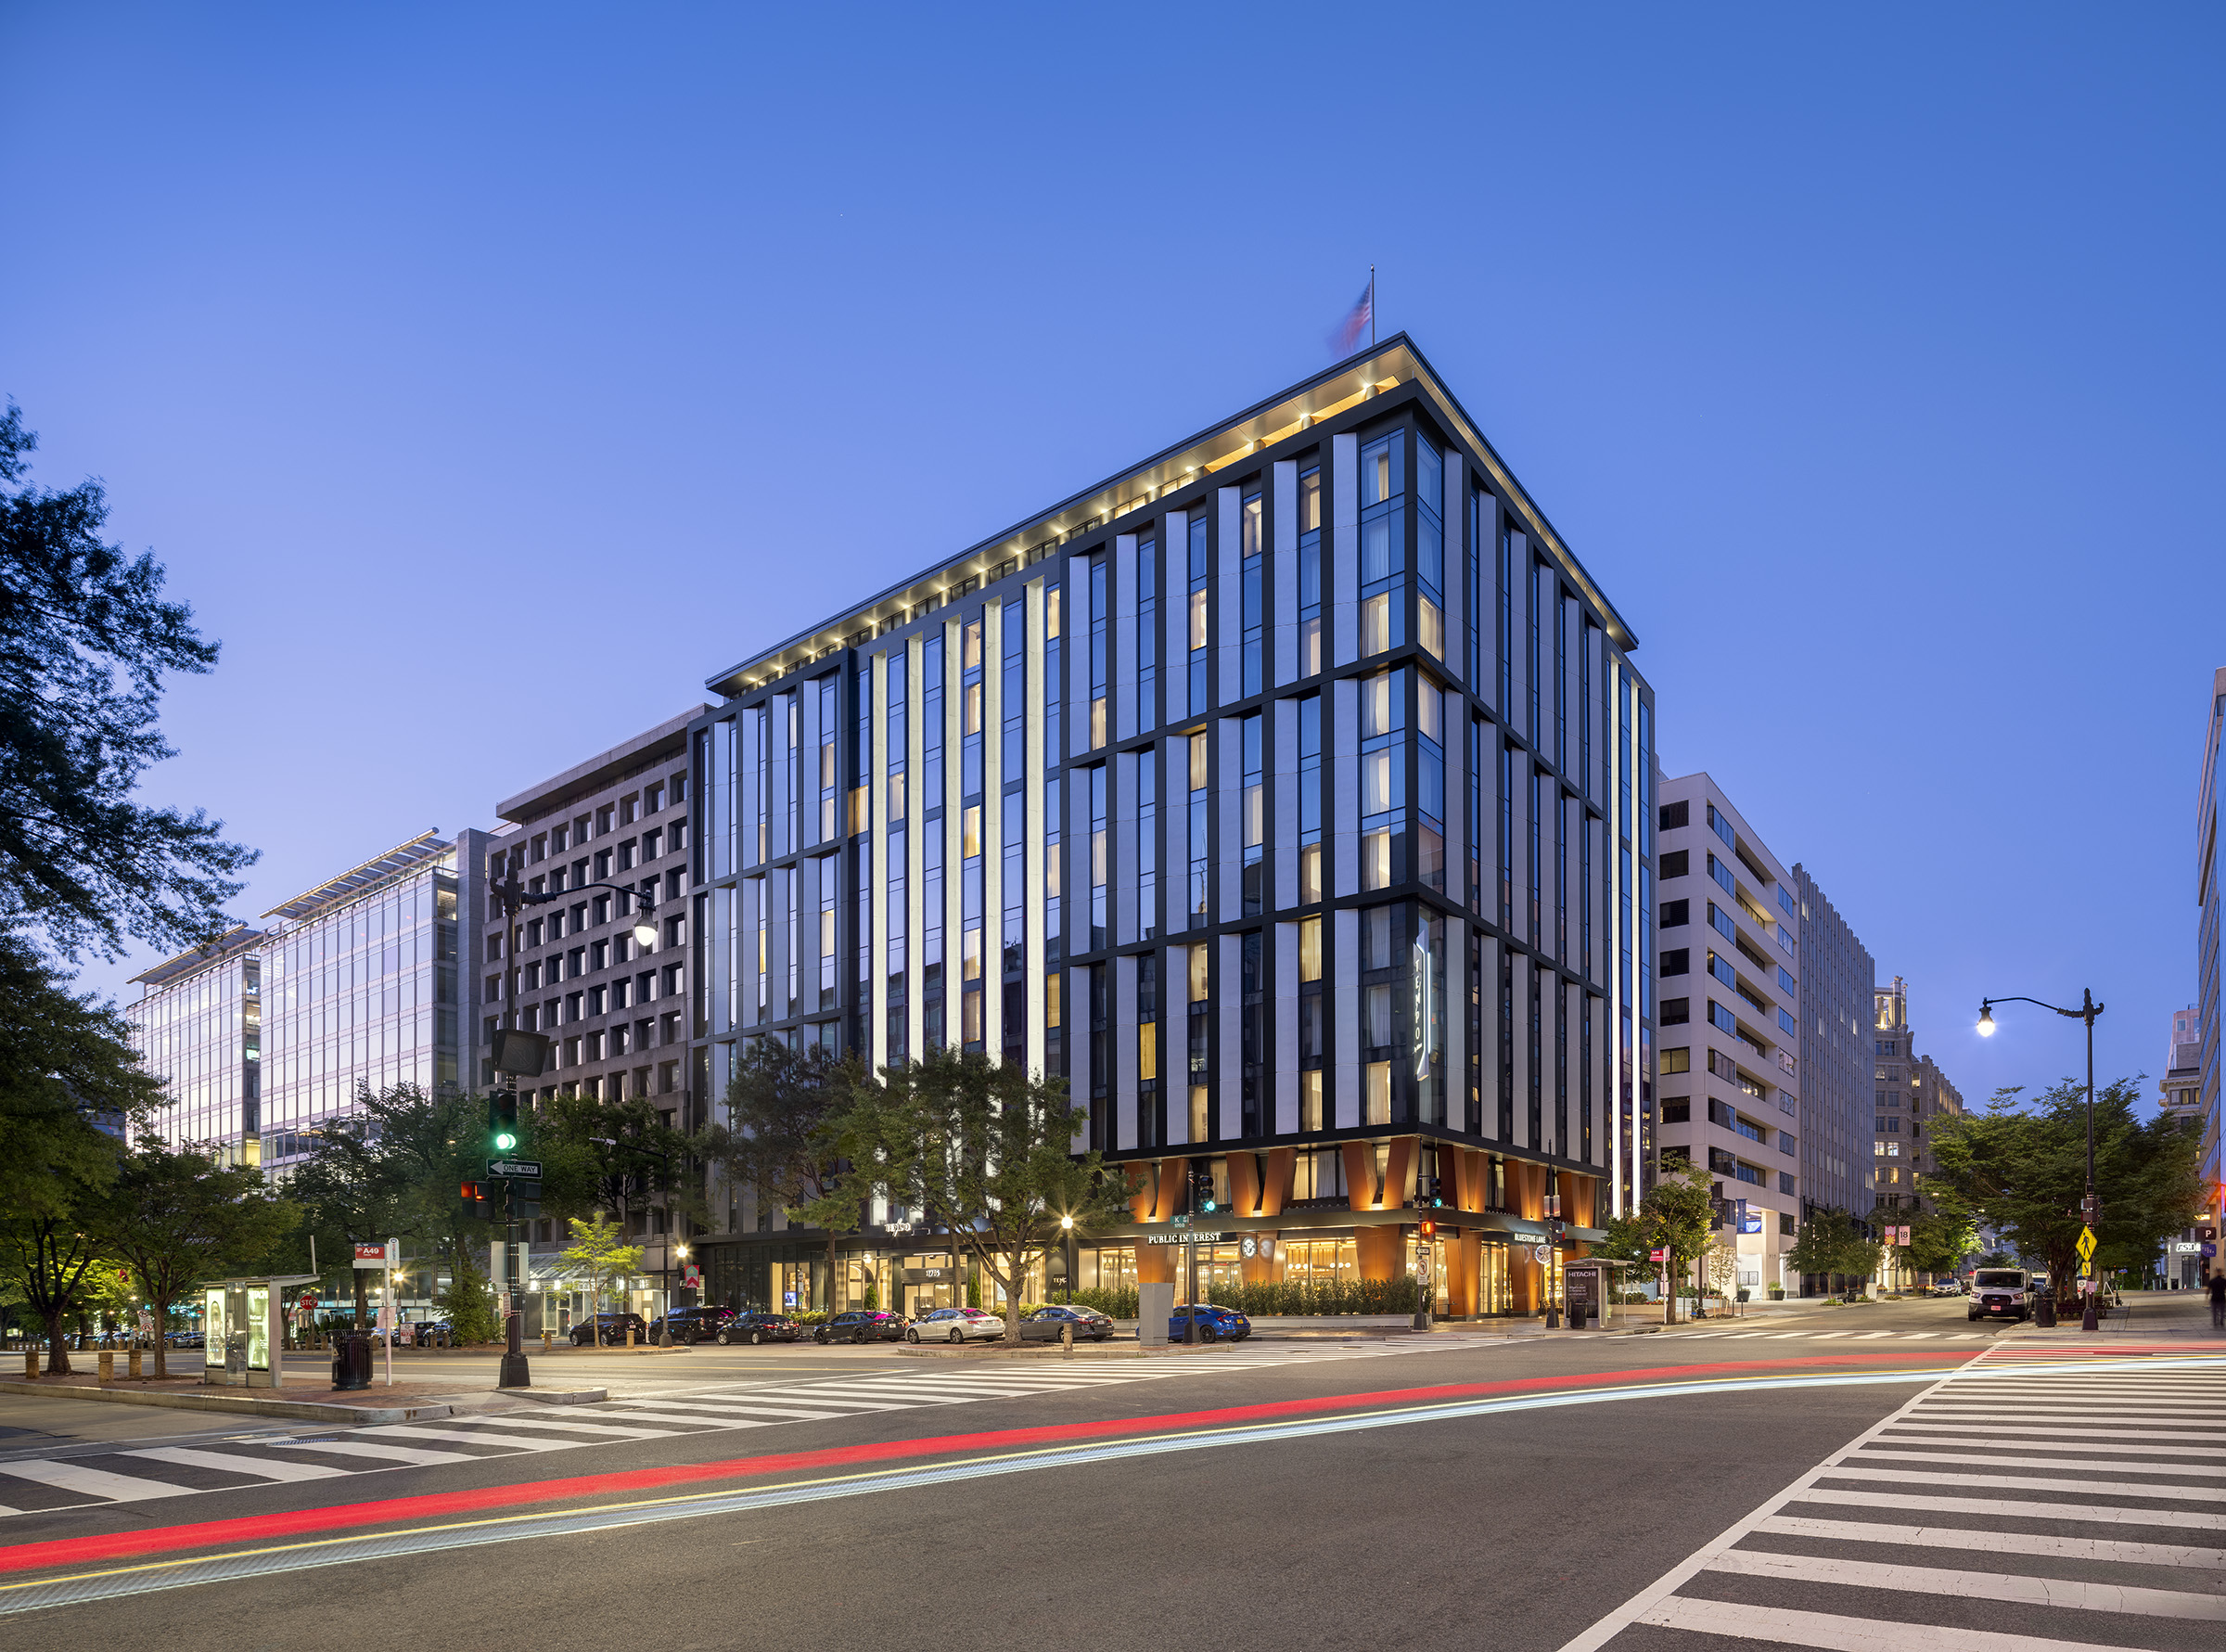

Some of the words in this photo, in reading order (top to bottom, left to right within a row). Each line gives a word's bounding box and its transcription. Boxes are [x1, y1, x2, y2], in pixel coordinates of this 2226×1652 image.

[503, 1164, 518, 1172] ONE
[520, 1165, 536, 1173] WAY
[1148, 1235, 1178, 1244] PUBLIC
[1179, 1232, 1222, 1243] INEREST
[1514, 1233, 1536, 1243] BLUESTONE
[1536, 1235, 1546, 1244] LANE
[2205, 1229, 2212, 1238] P
